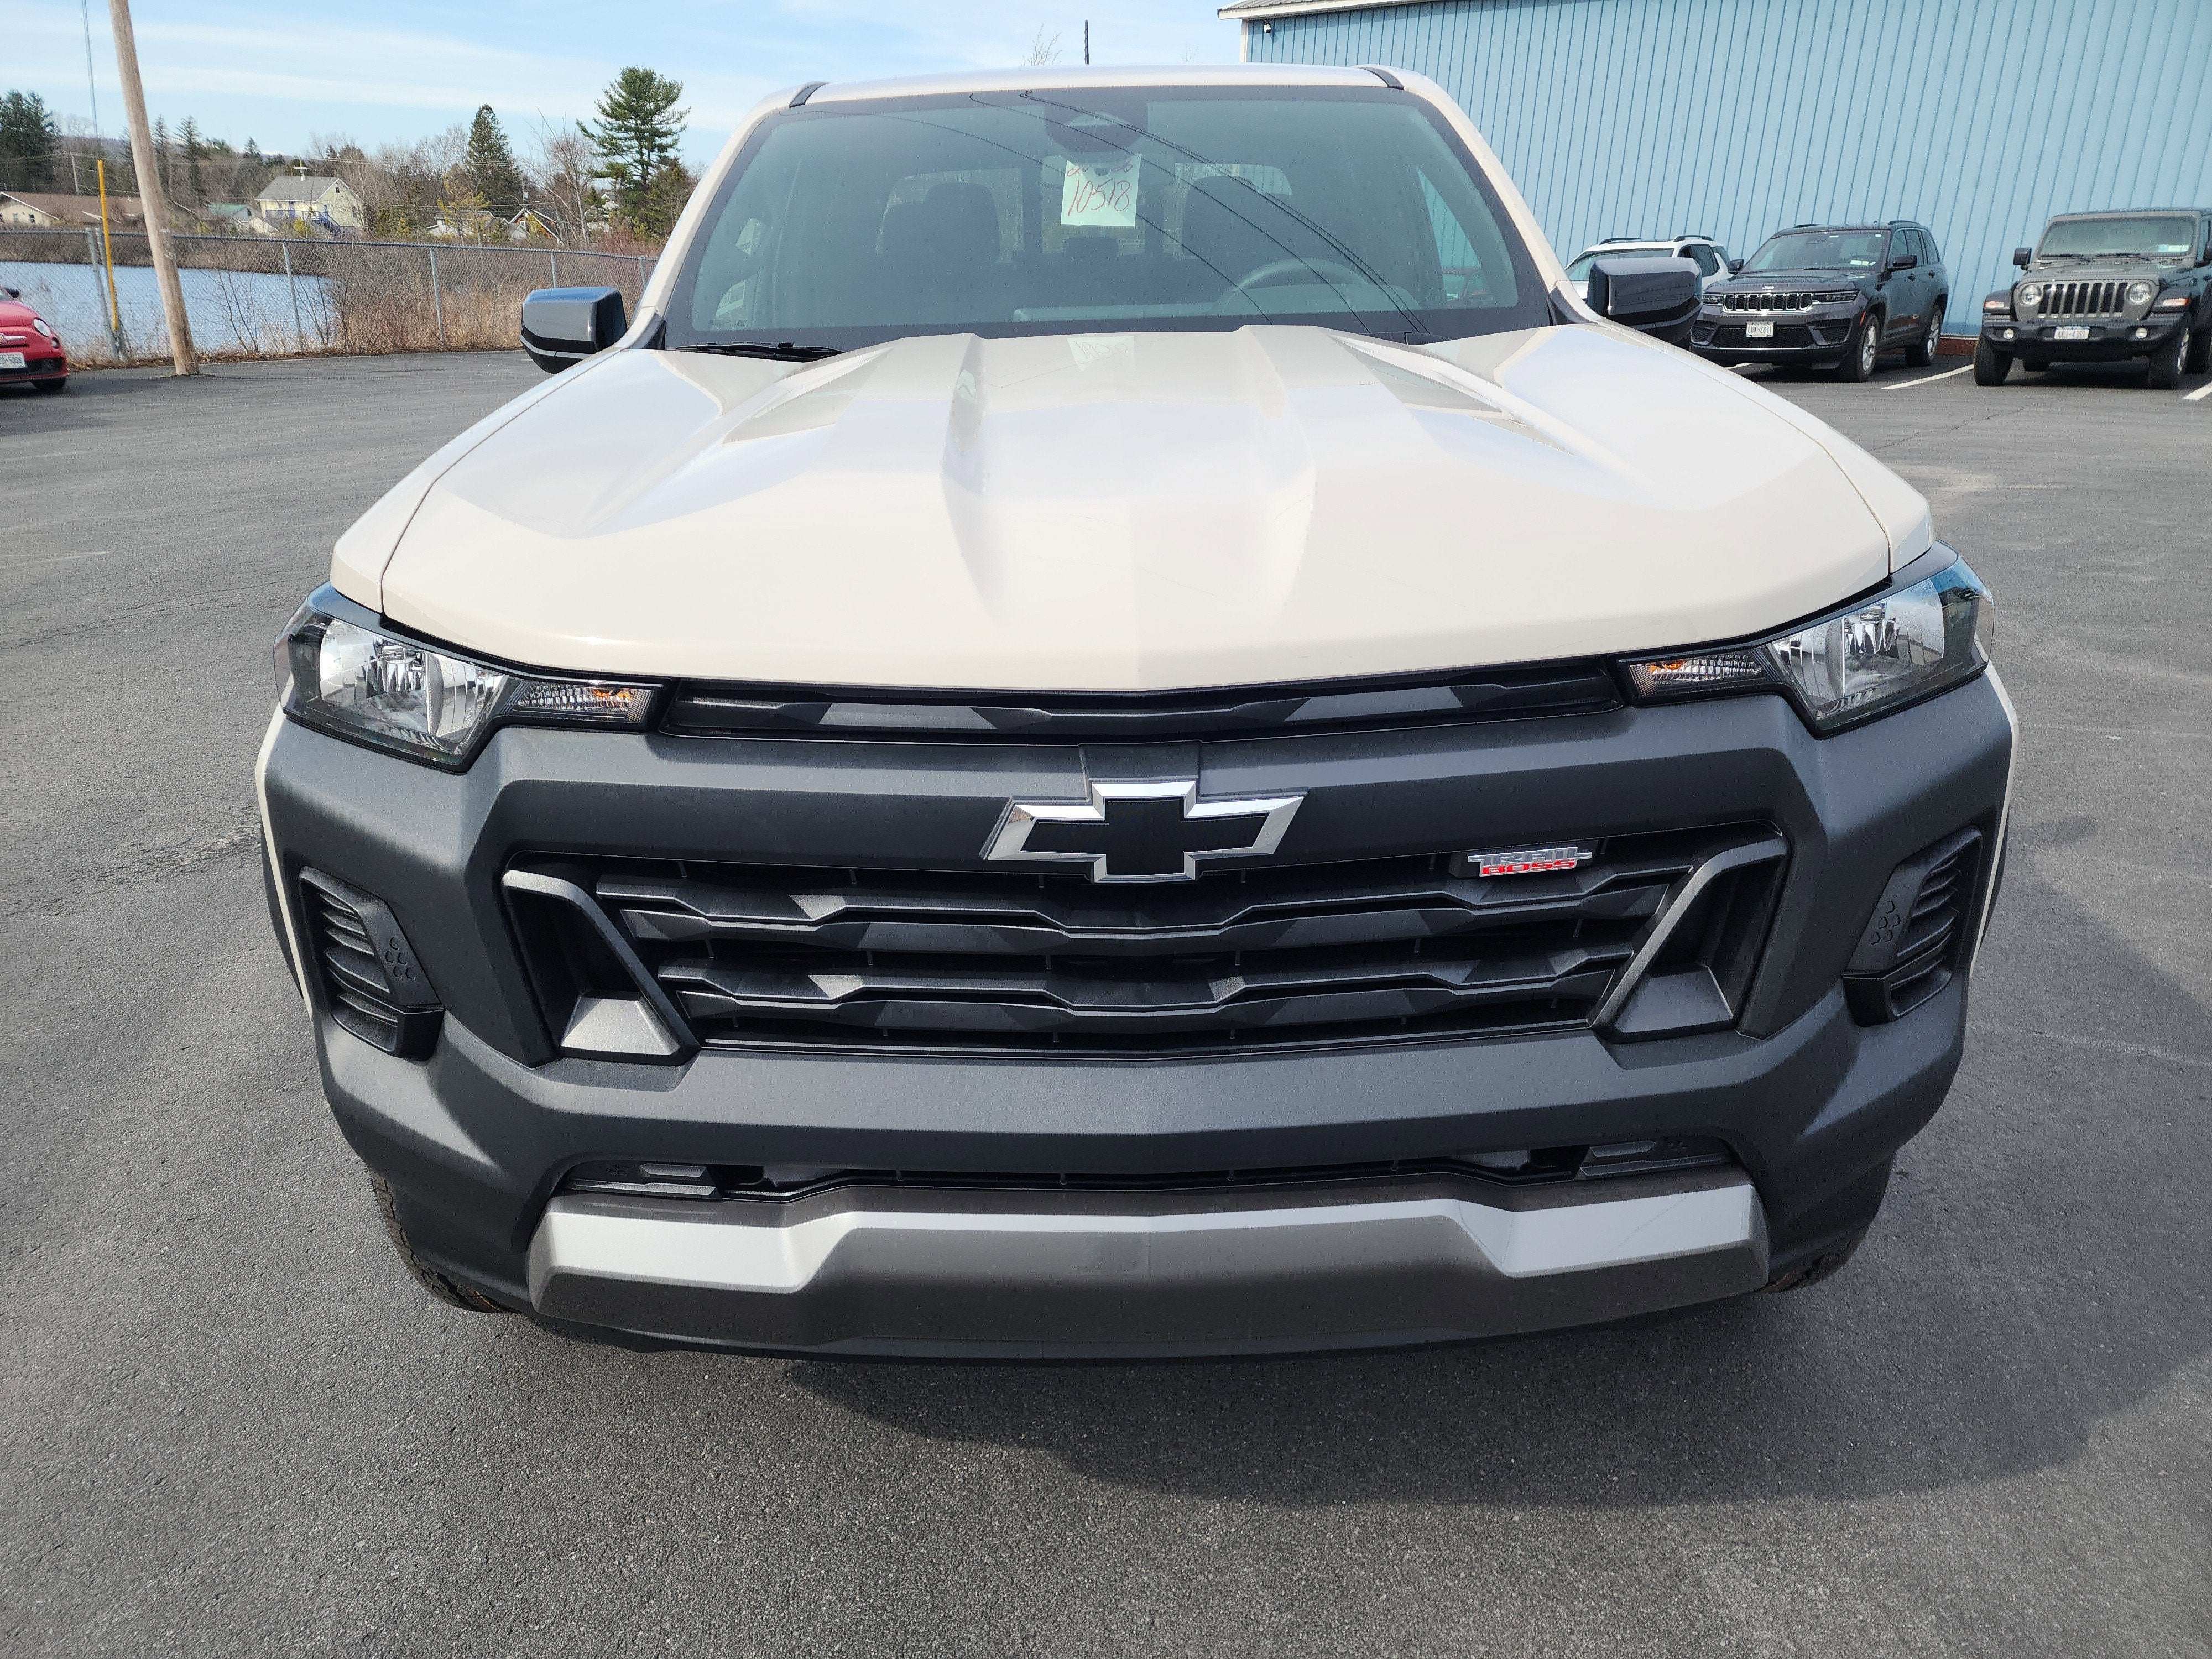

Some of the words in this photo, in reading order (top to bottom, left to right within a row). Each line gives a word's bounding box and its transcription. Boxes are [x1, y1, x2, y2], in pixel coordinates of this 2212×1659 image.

[1067, 178, 1131, 216] 10518
[1468, 847, 1592, 866] TRAIL
[1480, 859, 1577, 876] BOSS
